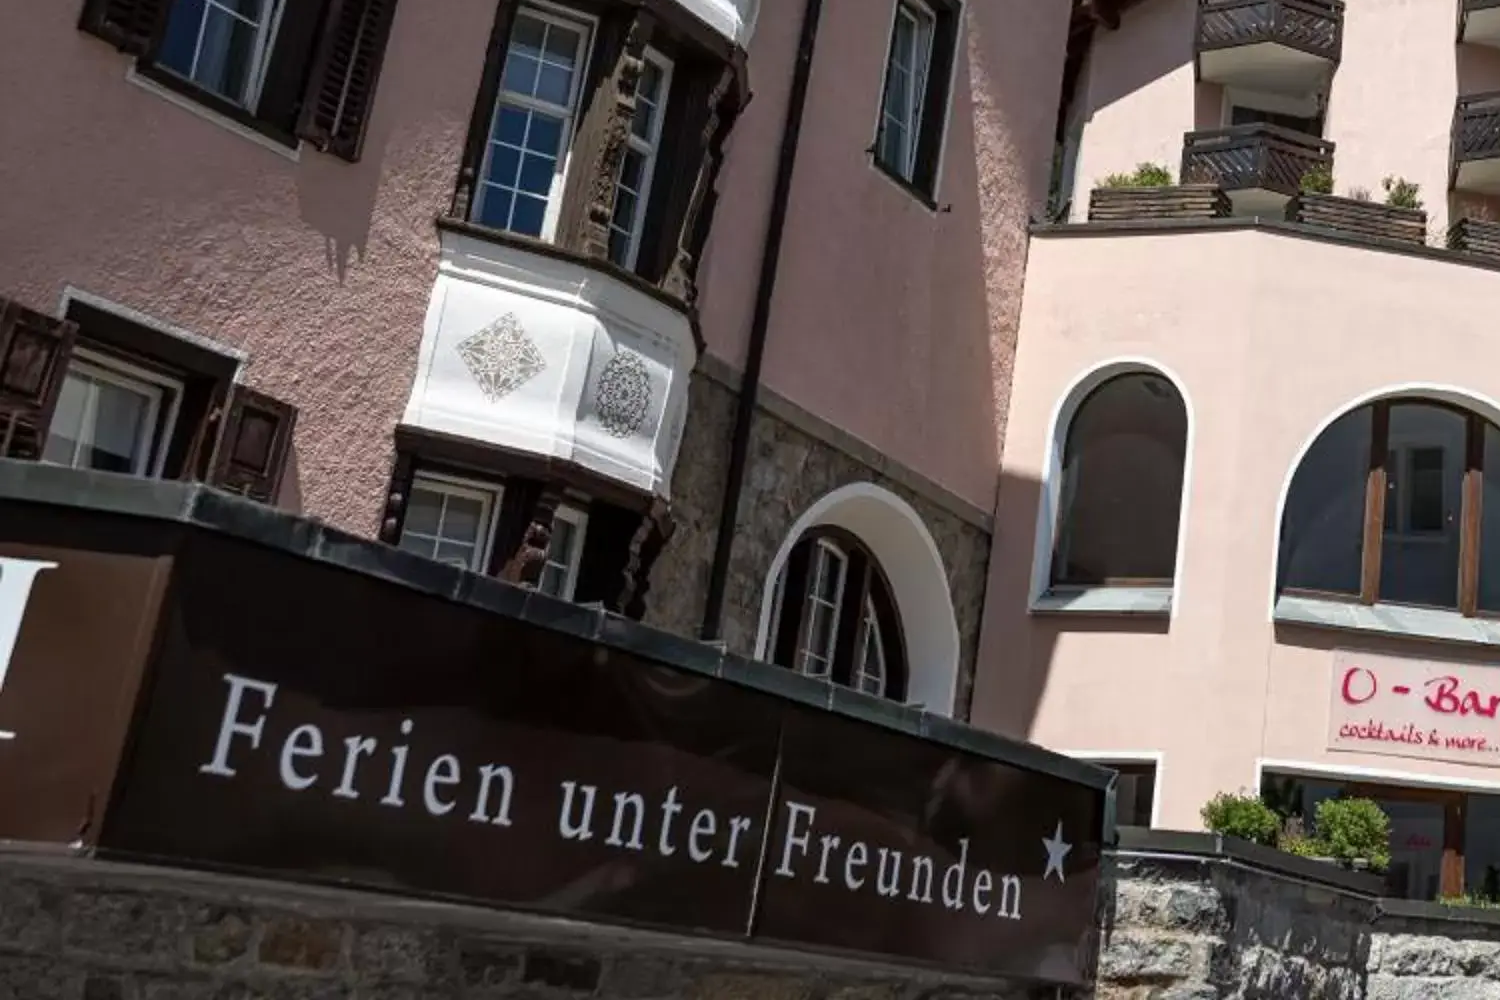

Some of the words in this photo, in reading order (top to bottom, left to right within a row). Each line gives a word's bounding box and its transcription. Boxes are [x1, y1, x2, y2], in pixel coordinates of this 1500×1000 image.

[1341, 667, 1378, 705] O
[1338, 719, 1424, 745] cocktails
[1427, 729, 1440, 746] &
[200, 673, 514, 827] Ferien
[558, 782, 752, 868] unter
[774, 800, 1022, 921] Freunden
